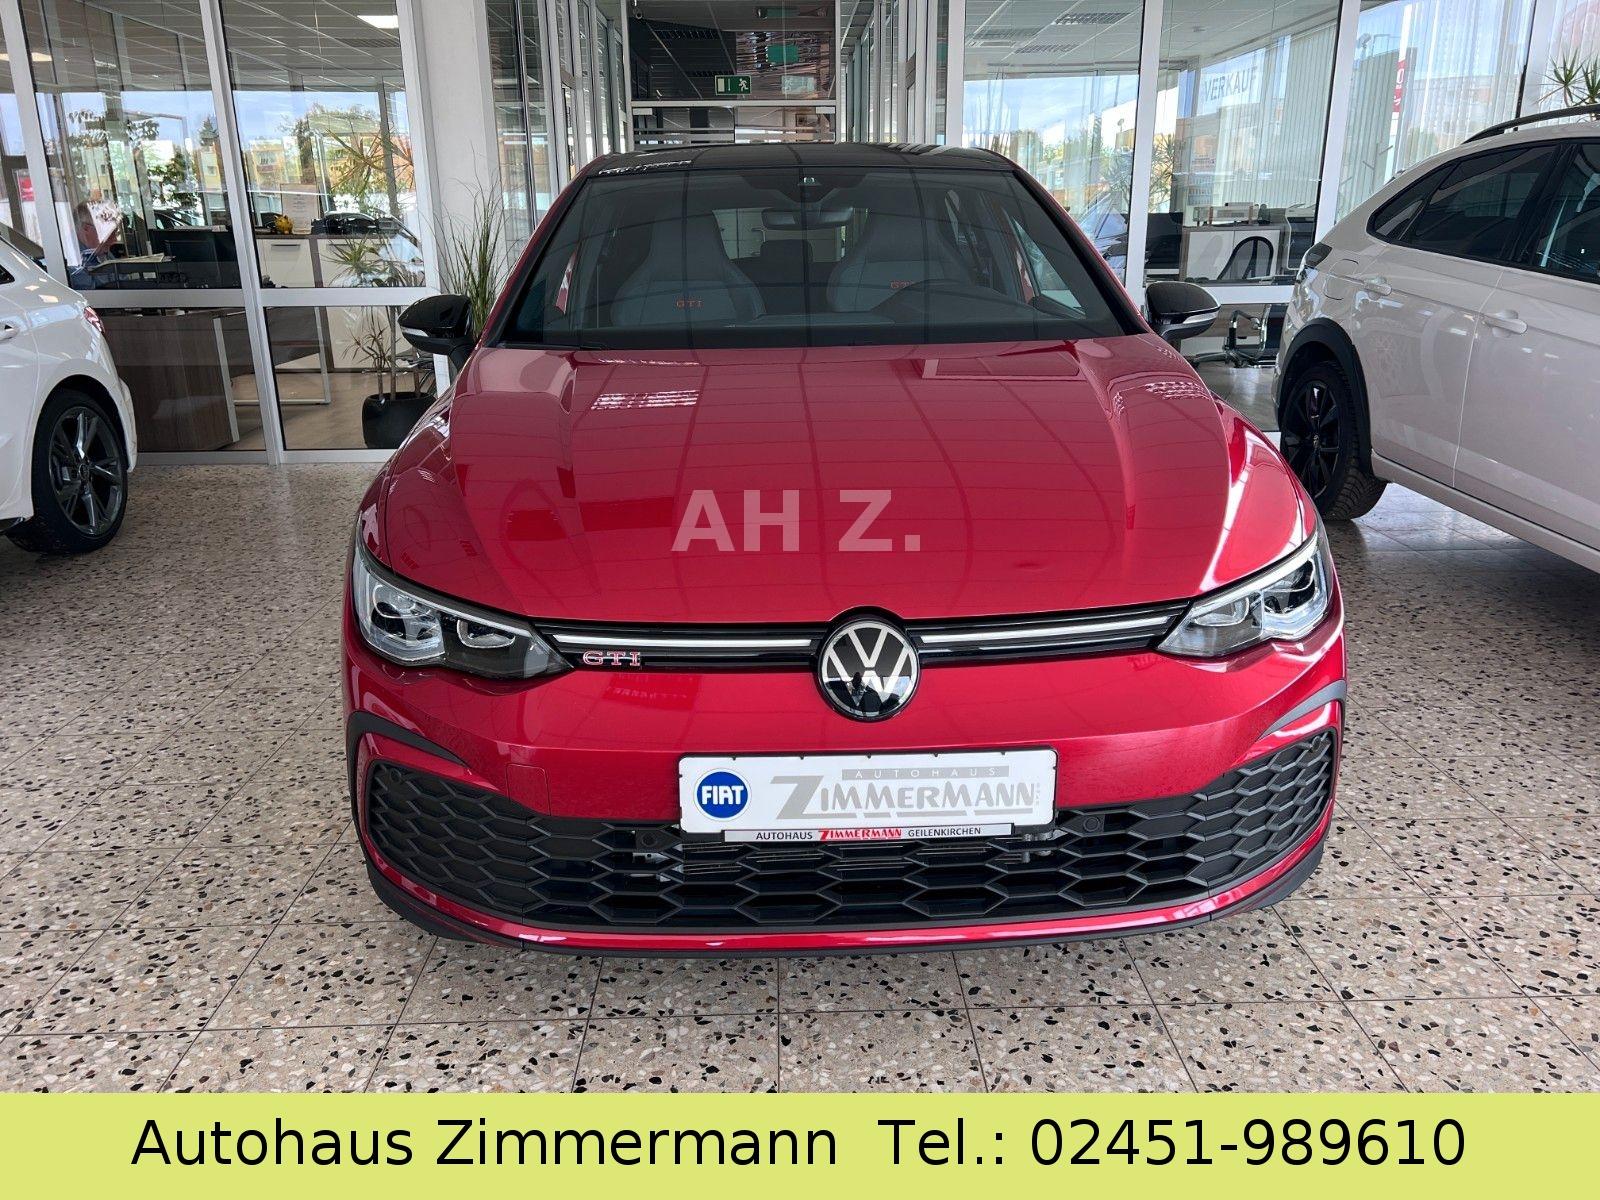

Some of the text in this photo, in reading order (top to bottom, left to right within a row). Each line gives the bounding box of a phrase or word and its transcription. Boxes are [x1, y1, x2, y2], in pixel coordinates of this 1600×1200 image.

[1204, 66, 1258, 101] VERKAUF
[582, 650, 641, 666] GTI
[855, 767, 997, 780] AUTOHAUS
[701, 785, 744, 805] FIAT
[770, 776, 1035, 820] ZIMMERMANN
[755, 827, 981, 841] AUTOHAUS ZIMMERMANN GEILENKIRCHEN
